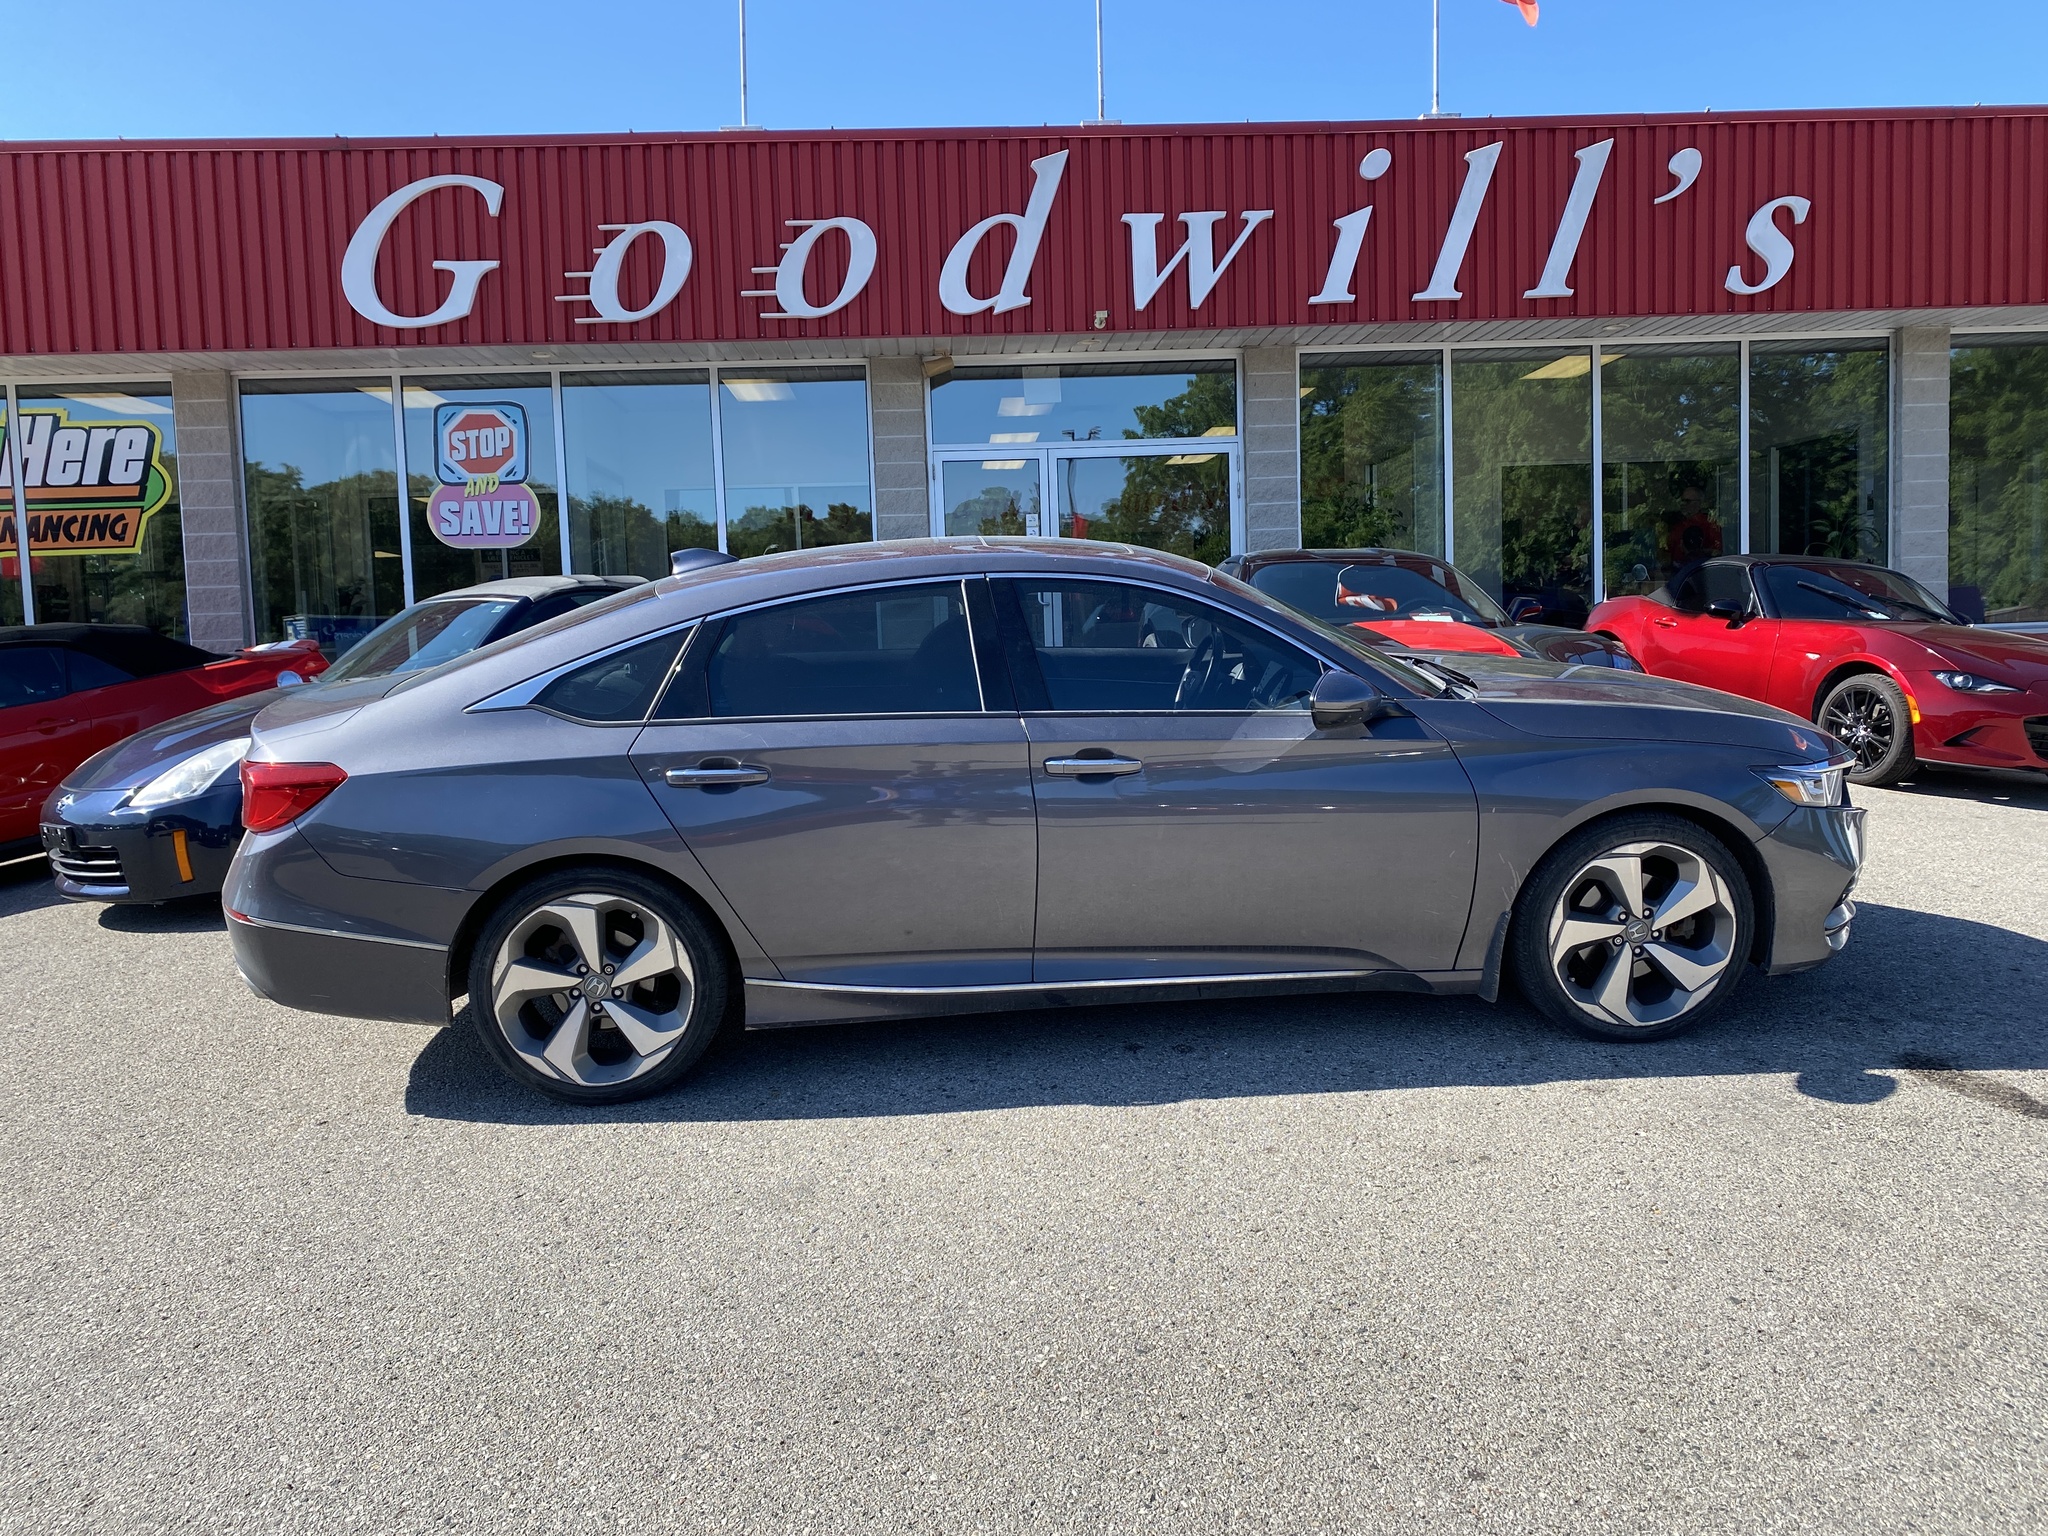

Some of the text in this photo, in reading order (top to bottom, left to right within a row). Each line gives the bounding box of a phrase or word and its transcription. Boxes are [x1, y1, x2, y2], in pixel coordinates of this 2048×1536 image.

[341, 138, 1811, 328] Goodwill's
[0, 416, 149, 486] Here
[450, 426, 510, 461] STOP
[464, 474, 499, 497] AND
[0, 513, 129, 543] NANCING
[439, 500, 530, 536] SAVE!
